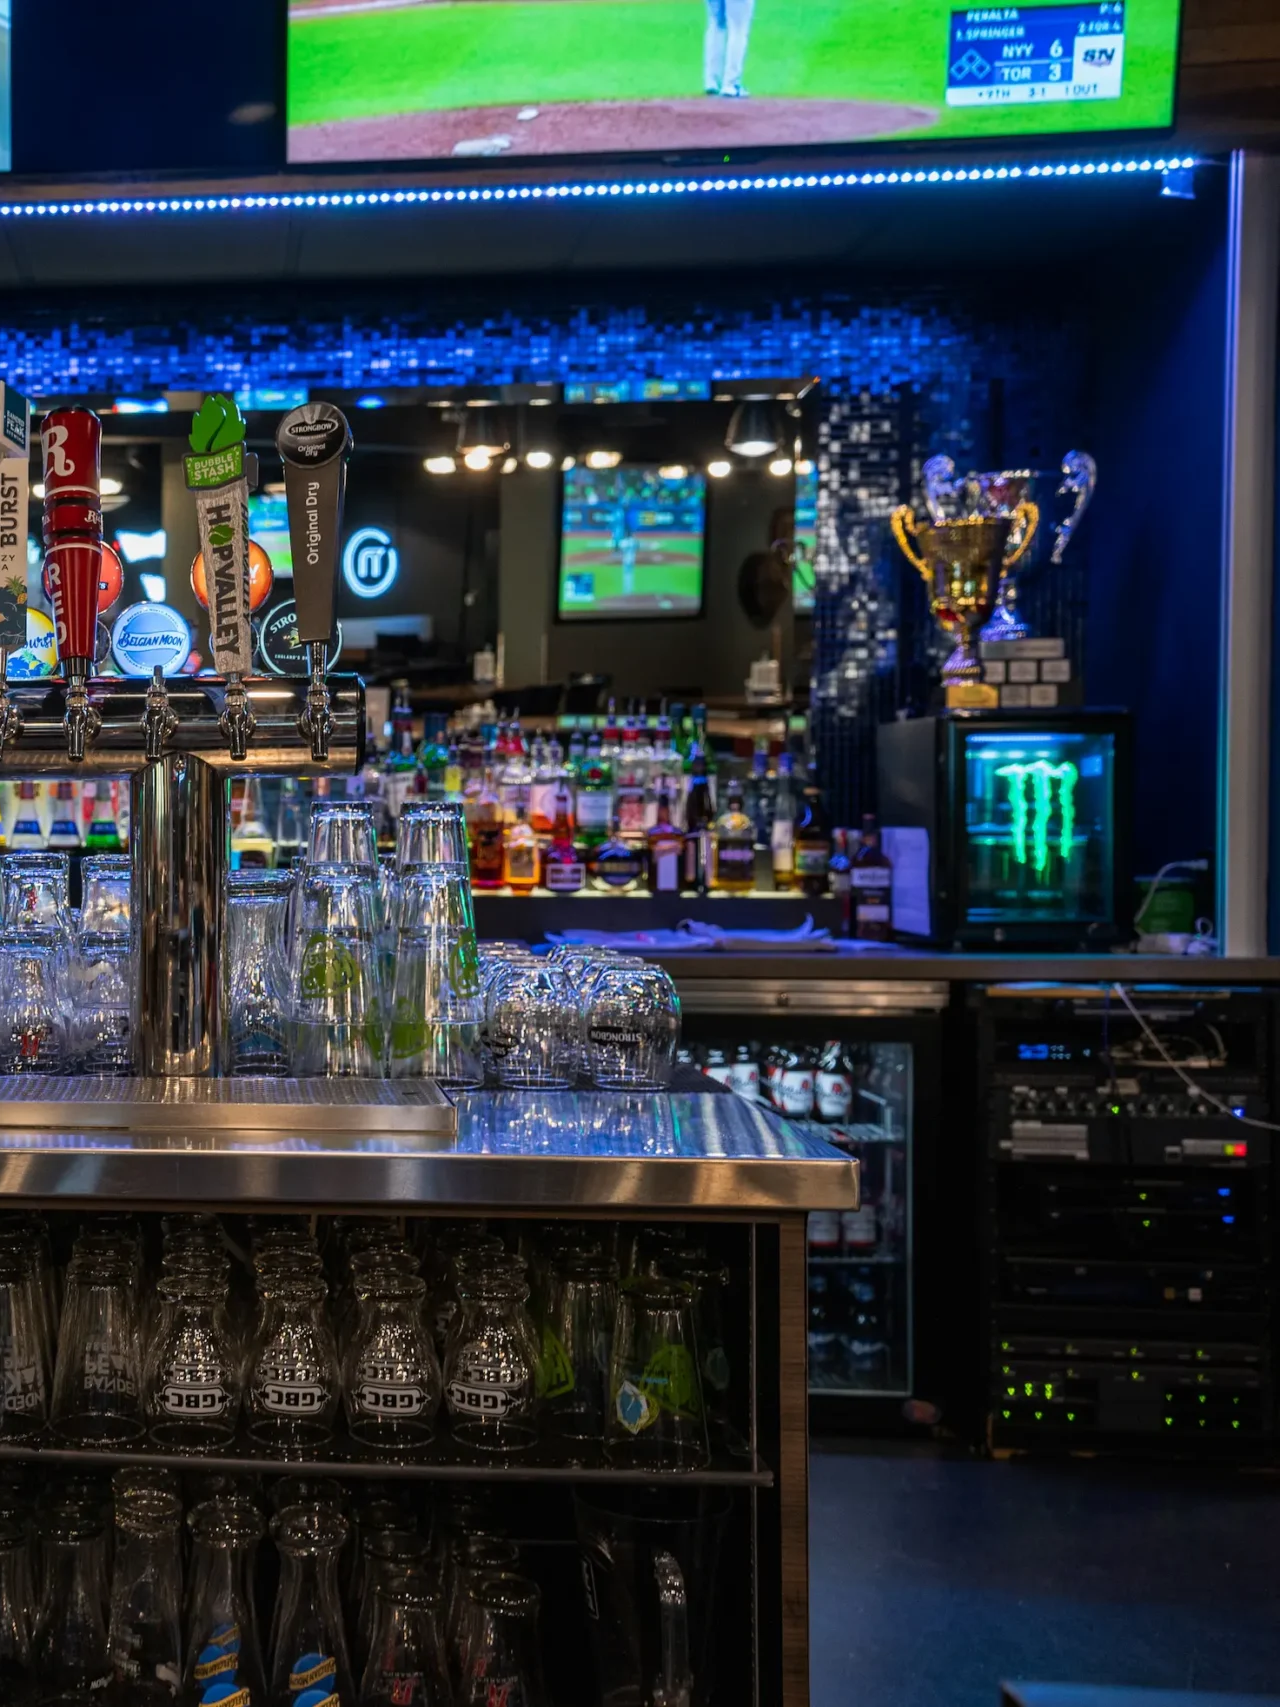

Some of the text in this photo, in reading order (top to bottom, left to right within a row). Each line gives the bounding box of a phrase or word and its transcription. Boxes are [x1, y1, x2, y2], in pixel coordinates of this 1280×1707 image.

[966, 8, 1019, 22] PERALTA
[1002, 39, 1063, 58] NYY 6
[1001, 63, 1062, 82] TOR 3
[291, 423, 333, 434] STRONGBOW
[297, 443, 326, 453] Original
[305, 449, 318, 457] Dry
[194, 454, 233, 471] BUBBLE
[194, 465, 235, 481] STASH
[0, 472, 18, 548] BURST
[307, 481, 321, 565] Original Dry
[118, 632, 184, 648] BELGIAN MOON
[171, 1393, 215, 1408] GBC
[271, 1390, 314, 1407] GBC
[368, 1392, 413, 1408] GBC
[455, 1389, 498, 1409] GBC
